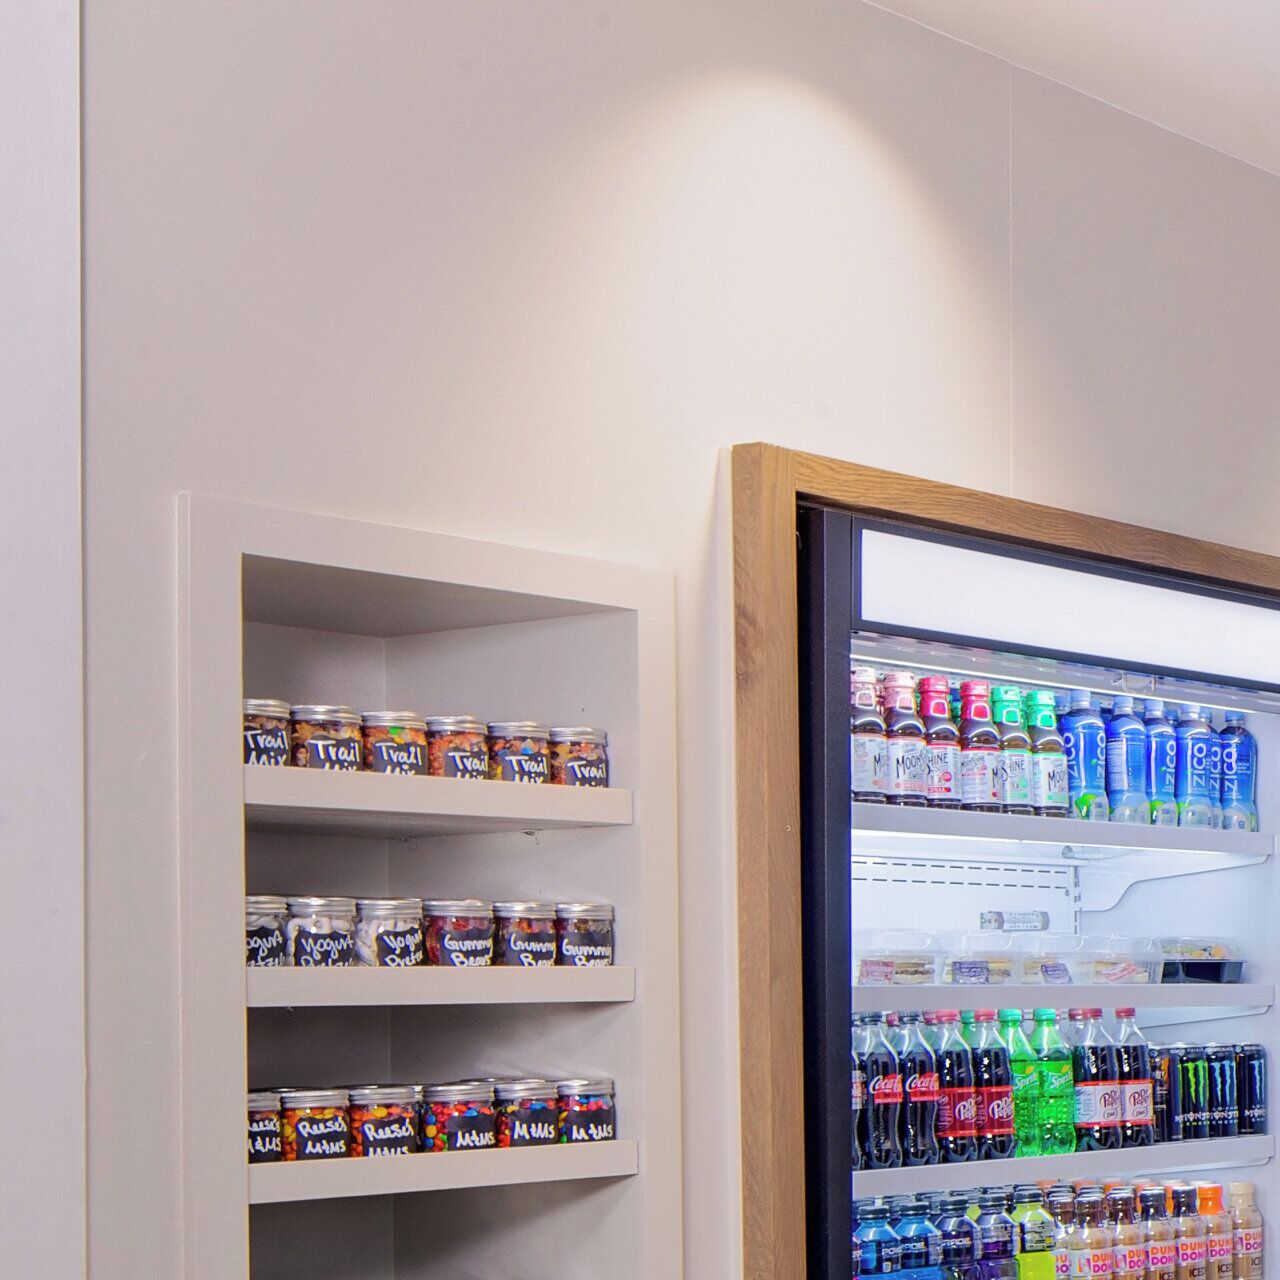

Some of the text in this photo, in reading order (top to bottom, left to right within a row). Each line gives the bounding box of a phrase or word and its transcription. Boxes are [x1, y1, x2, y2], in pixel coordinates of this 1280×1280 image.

[243, 730, 288, 750] Trail
[308, 740, 361, 763] Trail
[447, 752, 489, 771] Trail
[505, 755, 548, 774] Trail
[567, 760, 607, 779] Trail
[1193, 742, 1207, 788] ZICO
